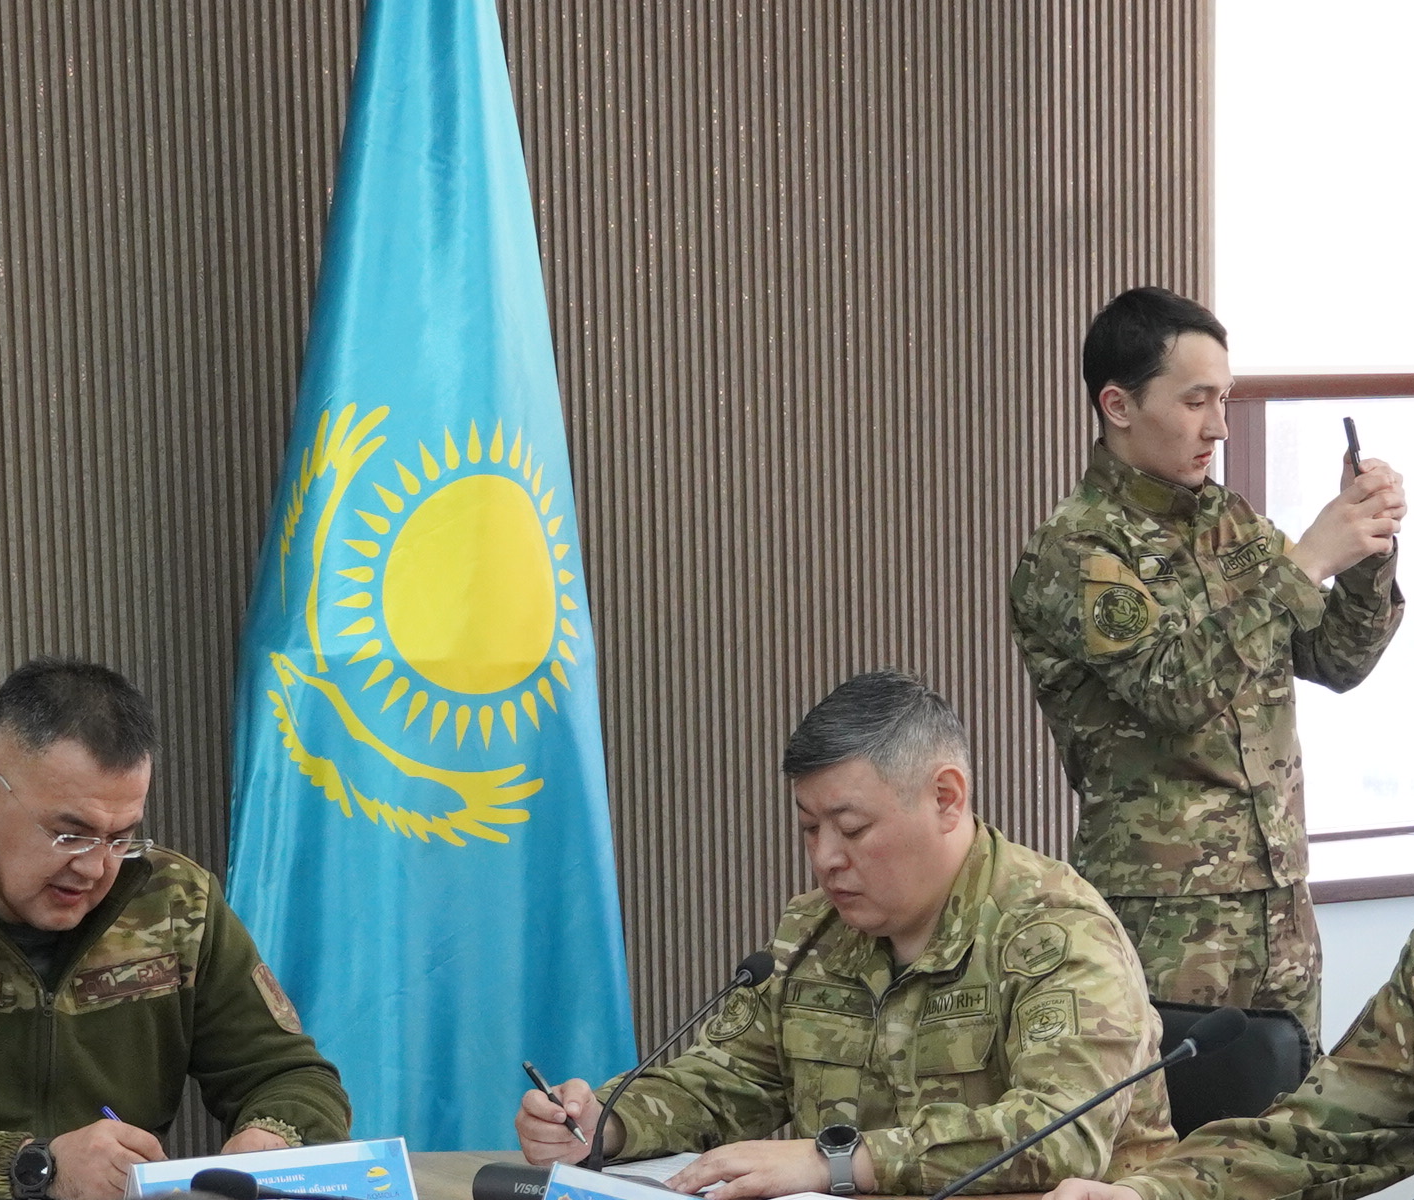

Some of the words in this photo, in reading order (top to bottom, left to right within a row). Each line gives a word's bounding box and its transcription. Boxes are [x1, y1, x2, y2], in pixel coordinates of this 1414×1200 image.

[956, 992, 984, 1009] Rh+
[257, 1173, 305, 1186] ачальник
[309, 1183, 348, 1195] области
